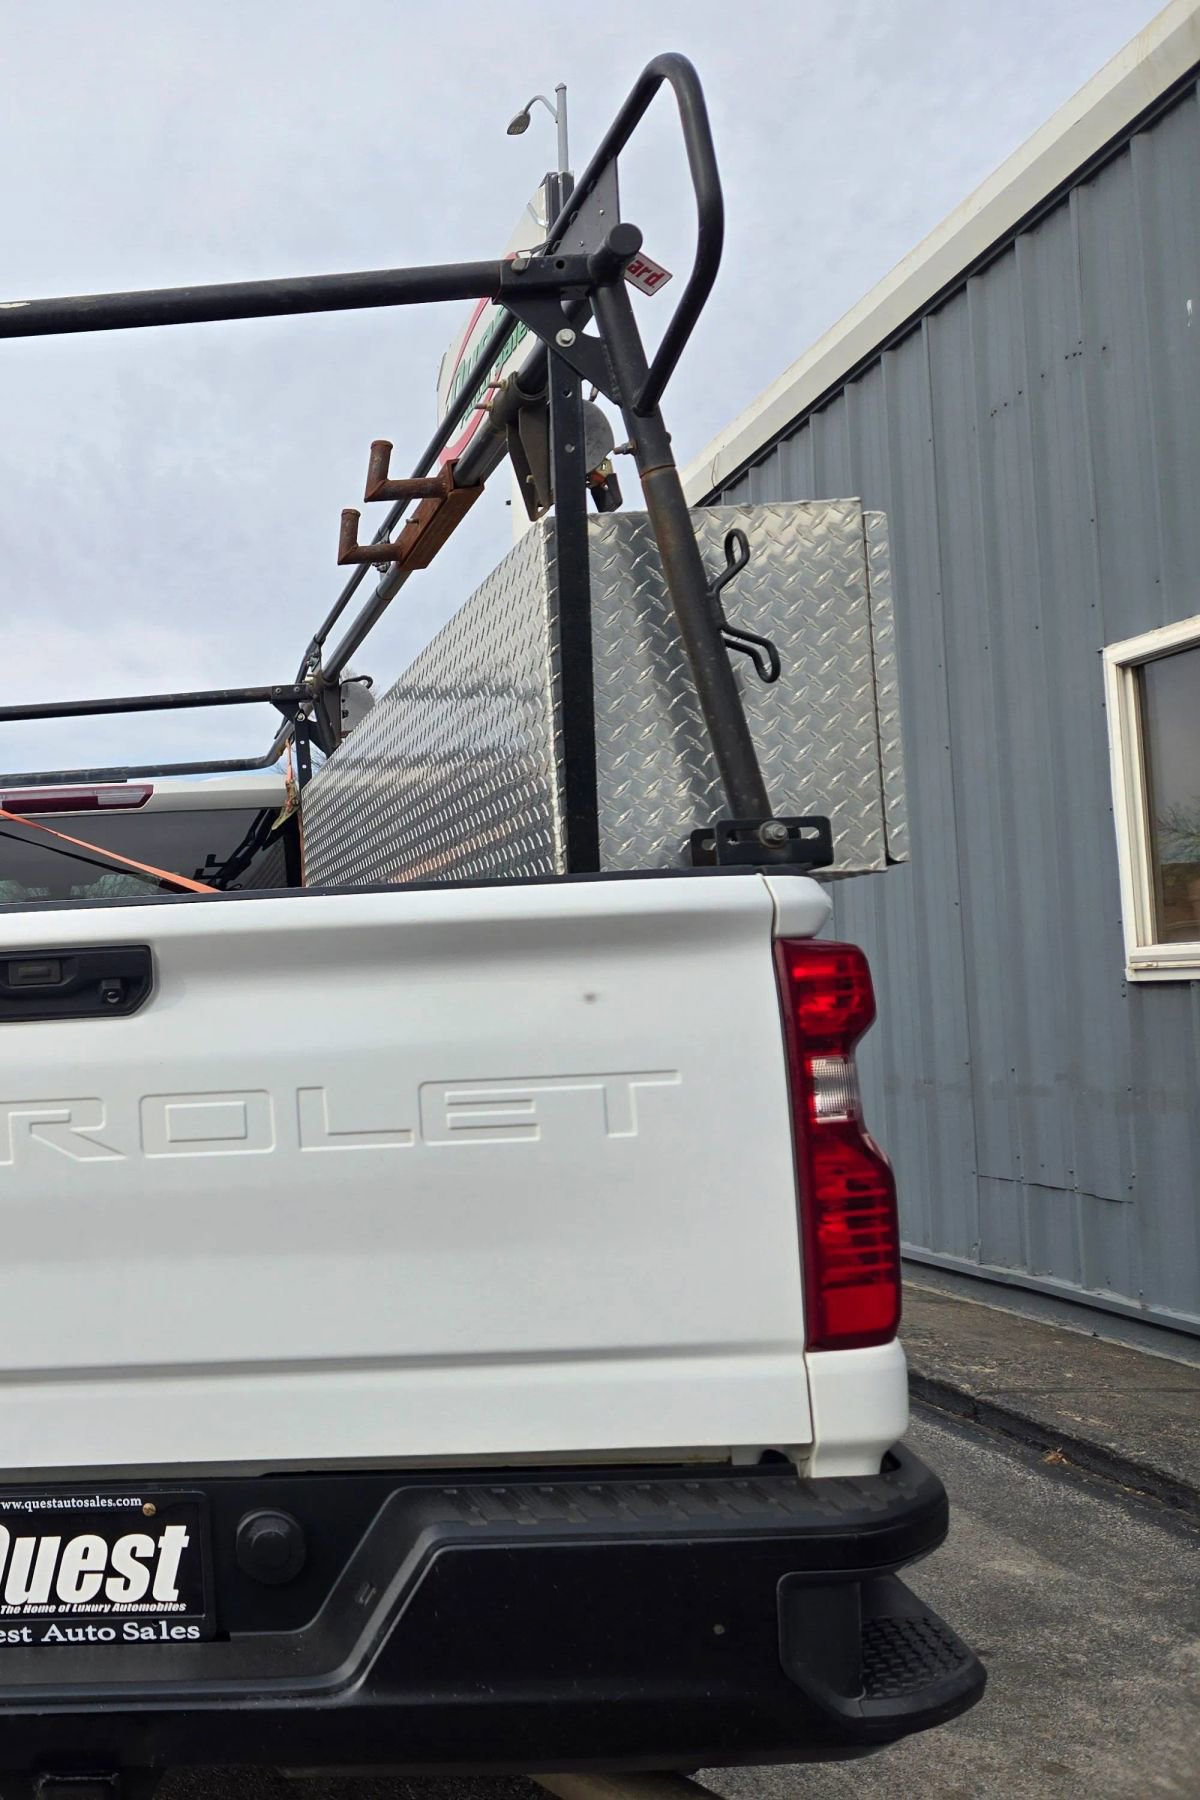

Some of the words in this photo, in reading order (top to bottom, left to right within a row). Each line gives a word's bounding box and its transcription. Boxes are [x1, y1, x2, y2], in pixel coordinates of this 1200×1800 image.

[627, 260, 665, 287] ard
[0, 1604, 21, 1615] The
[22, 1604, 57, 1614] Home
[58, 1603, 72, 1613] of
[71, 1602, 112, 1614] Luxury
[111, 1602, 187, 1612] Automobiles
[41, 1623, 116, 1643] Auto
[122, 1620, 201, 1641] Sales
